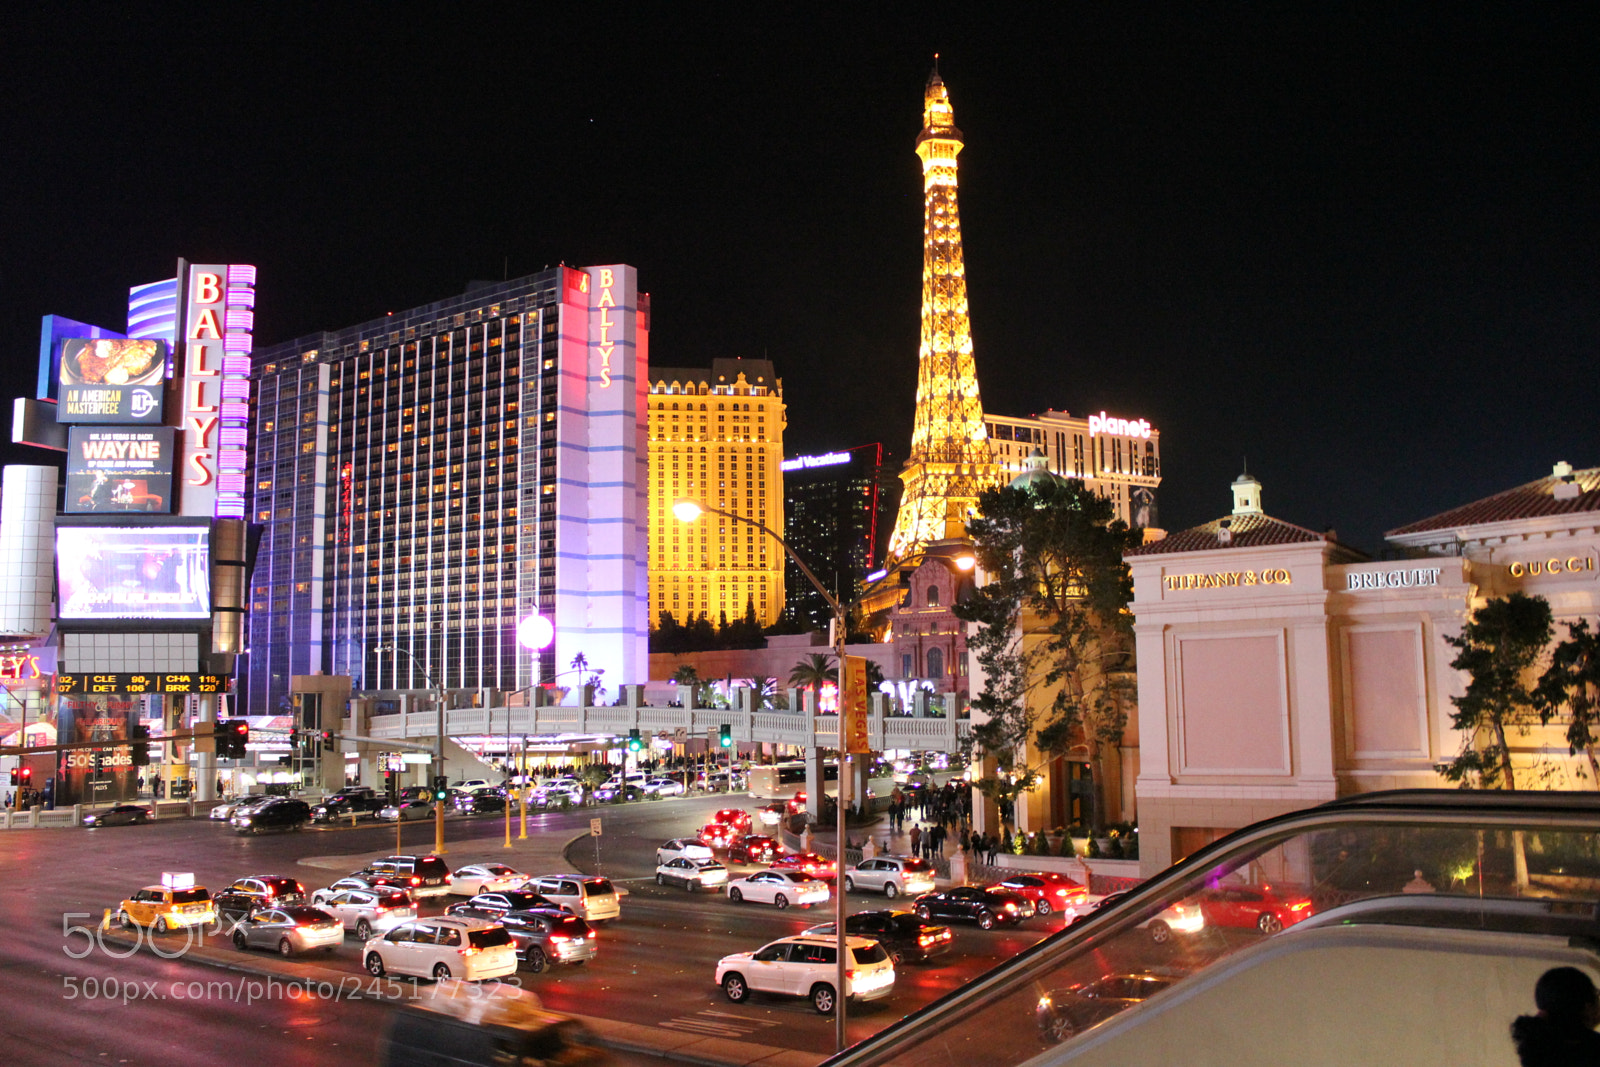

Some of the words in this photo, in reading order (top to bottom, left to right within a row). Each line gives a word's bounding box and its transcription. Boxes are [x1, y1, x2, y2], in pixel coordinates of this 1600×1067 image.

[82, 390, 121, 402] AMERICAN
[67, 402, 119, 414] MASTERPIECE
[1088, 410, 1151, 438] planet
[82, 440, 160, 460] WAYNE
[1510, 557, 1594, 578] GUCCI
[1164, 571, 1243, 591] TIFFANY
[1244, 570, 1257, 586] &
[1347, 568, 1441, 591] BREGUET
[93, 675, 117, 683] CLE
[131, 675, 145, 683] 90
[165, 675, 191, 683] CHA
[198, 675, 216, 683] 118
[855, 669, 865, 697] LAS
[855, 700, 867, 750] VEGAS
[67, 754, 87, 767] 50
[89, 753, 132, 767] Sades
